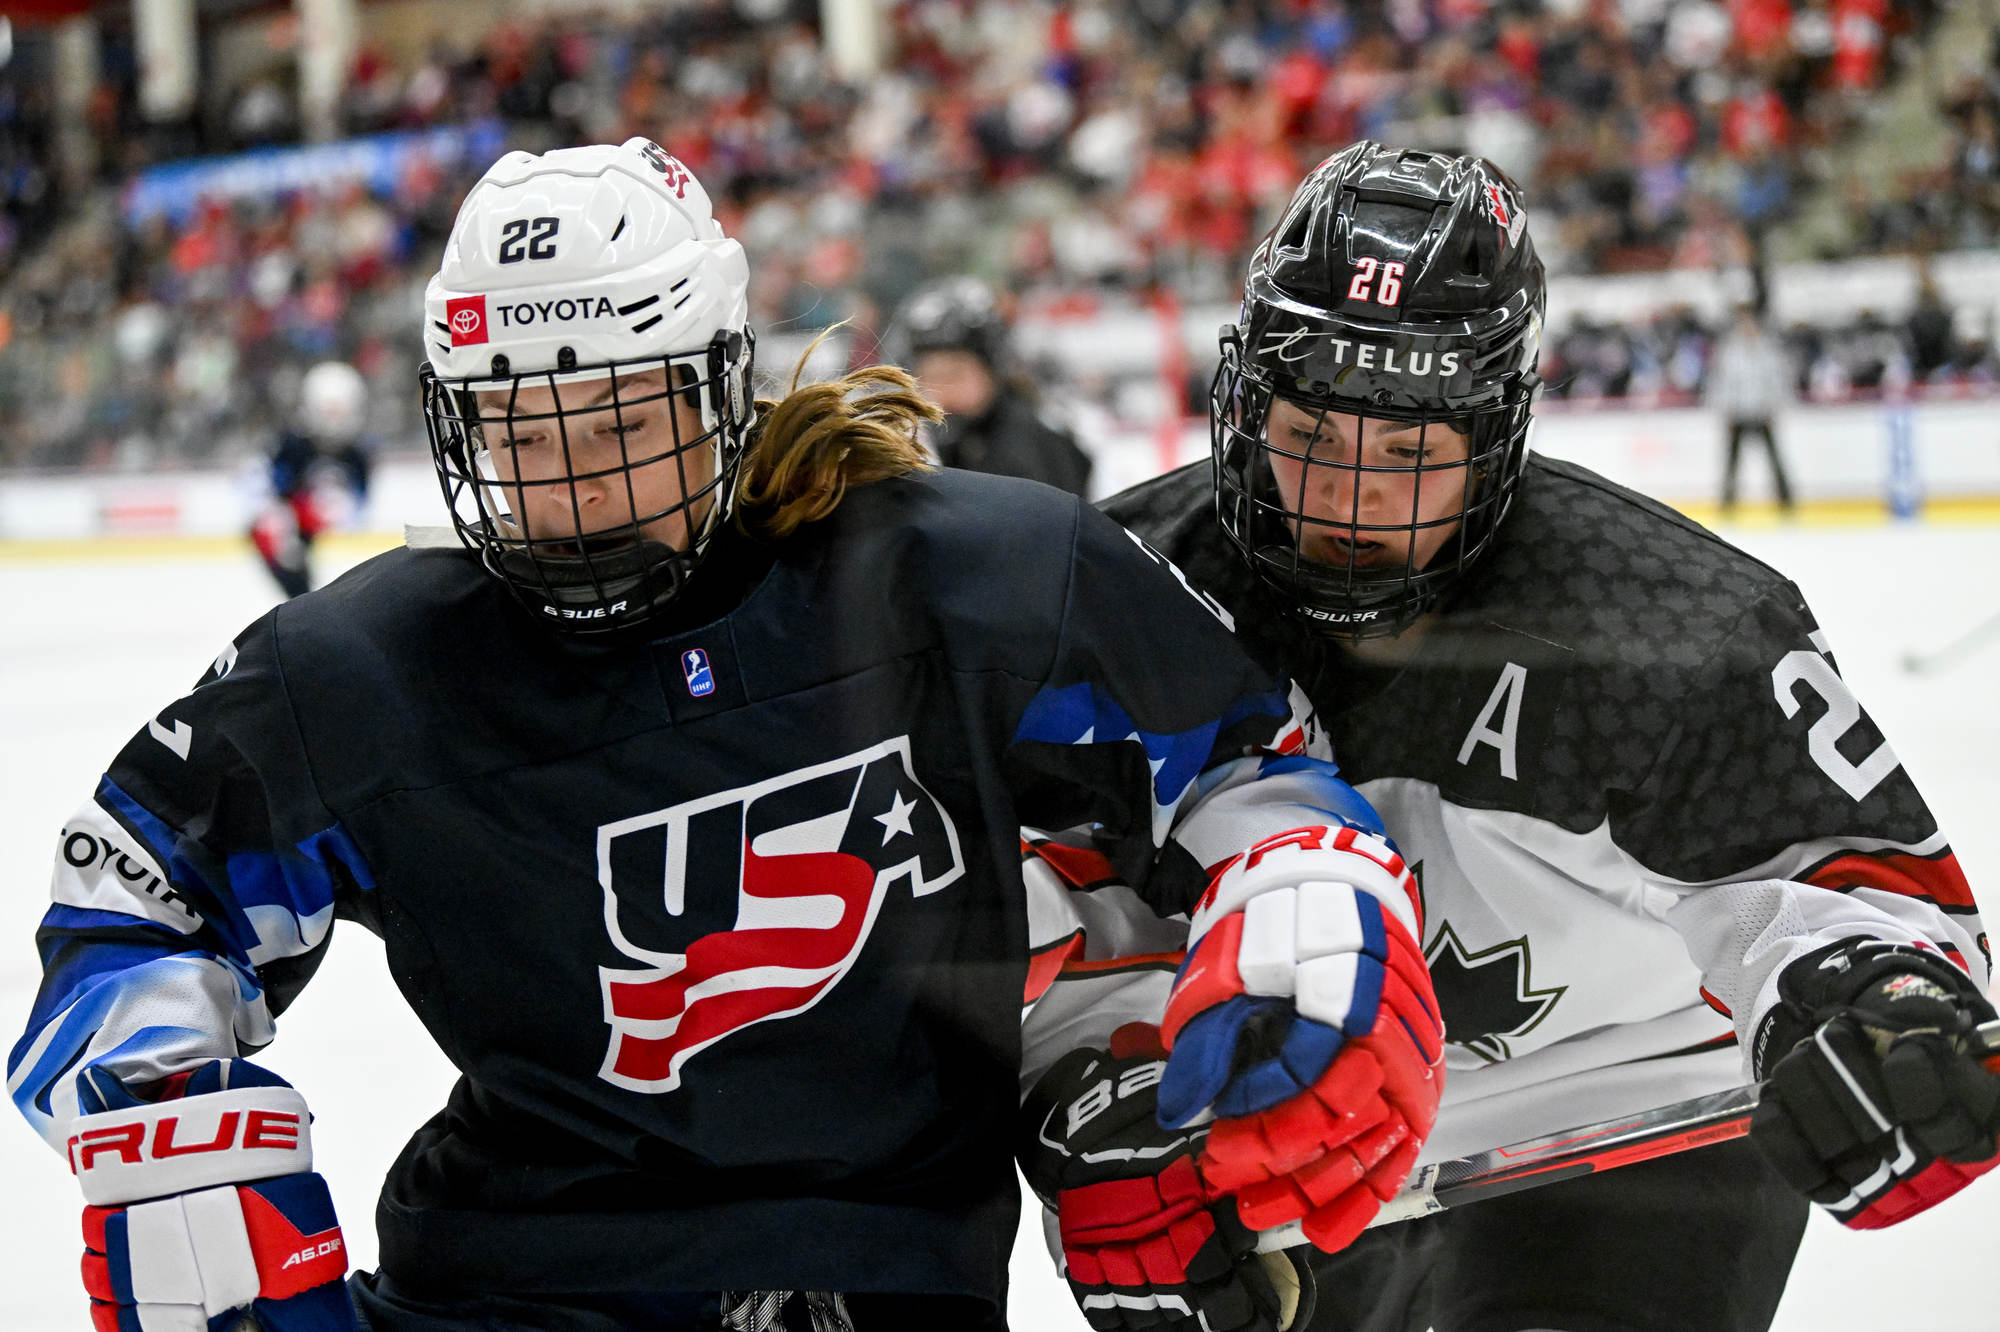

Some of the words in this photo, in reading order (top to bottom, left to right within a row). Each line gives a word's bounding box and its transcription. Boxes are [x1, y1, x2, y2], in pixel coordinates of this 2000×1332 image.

[499, 217, 560, 264] 22
[1347, 256, 1406, 307] 26
[496, 296, 616, 327] TOYOTA
[1330, 338, 1460, 377] TELUS
[543, 600, 628, 619] BAUER
[1456, 661, 1528, 782] A
[1771, 629, 1901, 803] 2
[597, 734, 966, 1094] USA
